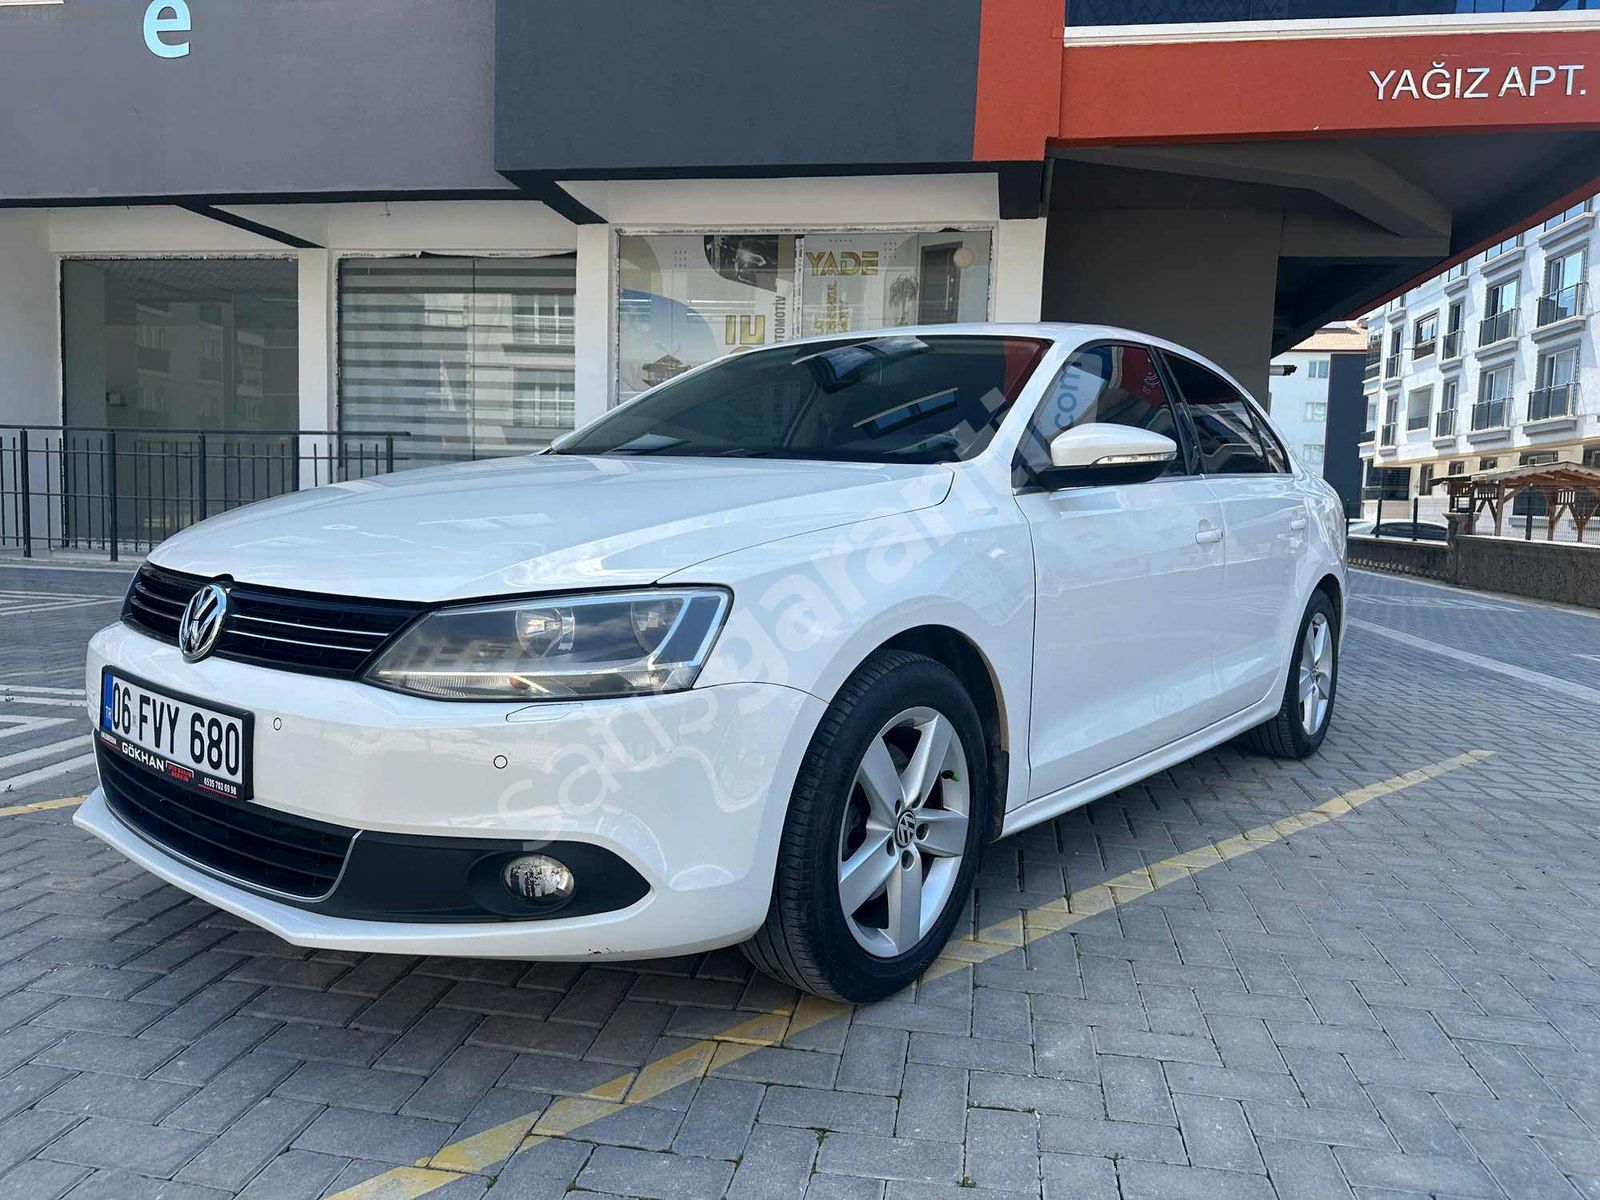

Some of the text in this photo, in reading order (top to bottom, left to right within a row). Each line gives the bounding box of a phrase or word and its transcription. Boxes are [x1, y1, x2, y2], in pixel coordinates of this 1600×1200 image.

[143, 0, 192, 58] e
[1369, 61, 1587, 100] YAĞIZ APT.
[804, 250, 879, 276] YADE
[113, 682, 240, 776] 06 FVY 680
[121, 741, 165, 772] GÖKHAN
